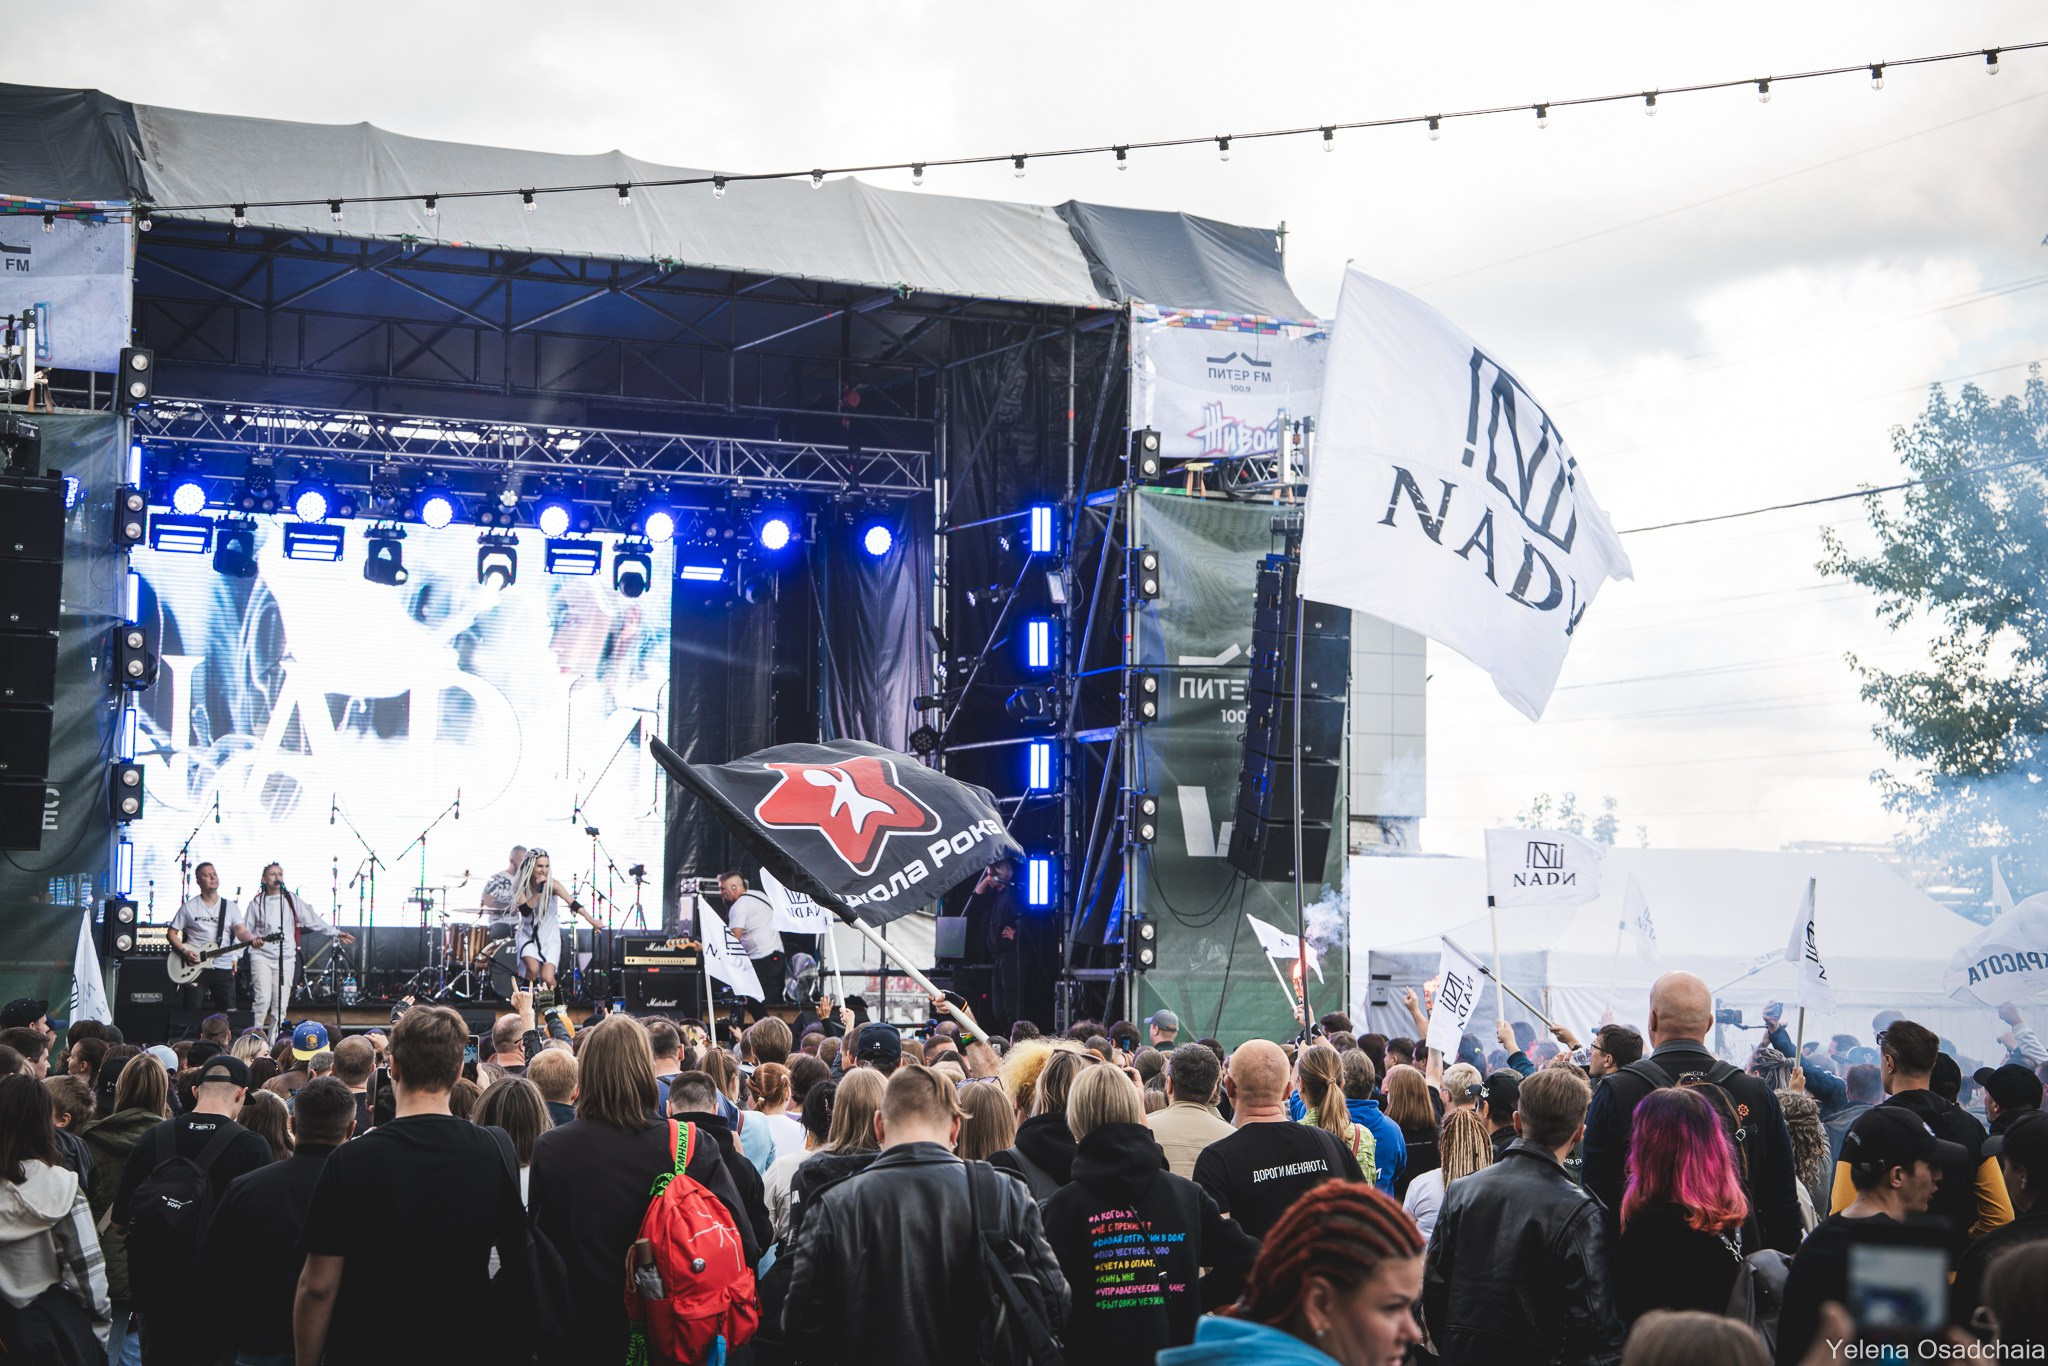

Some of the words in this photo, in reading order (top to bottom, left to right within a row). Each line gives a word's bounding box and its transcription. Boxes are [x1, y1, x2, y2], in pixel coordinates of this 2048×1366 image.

[5, 258, 30, 272] FM
[1208, 367, 1250, 383] ПИТЕР
[1254, 371, 1272, 383] FM
[1230, 384, 1251, 393] 100.9
[1179, 677, 1246, 700] ПИТЕ
[646, 997, 678, 1007] Marshall
[676, 1131, 688, 1172] УМНЫХ
[1253, 1166, 1285, 1183] ДОРОГИ
[1285, 1160, 1321, 1177] МЕНЯЮТ
[1130, 1258, 1156, 1268] ОПЛАТ
